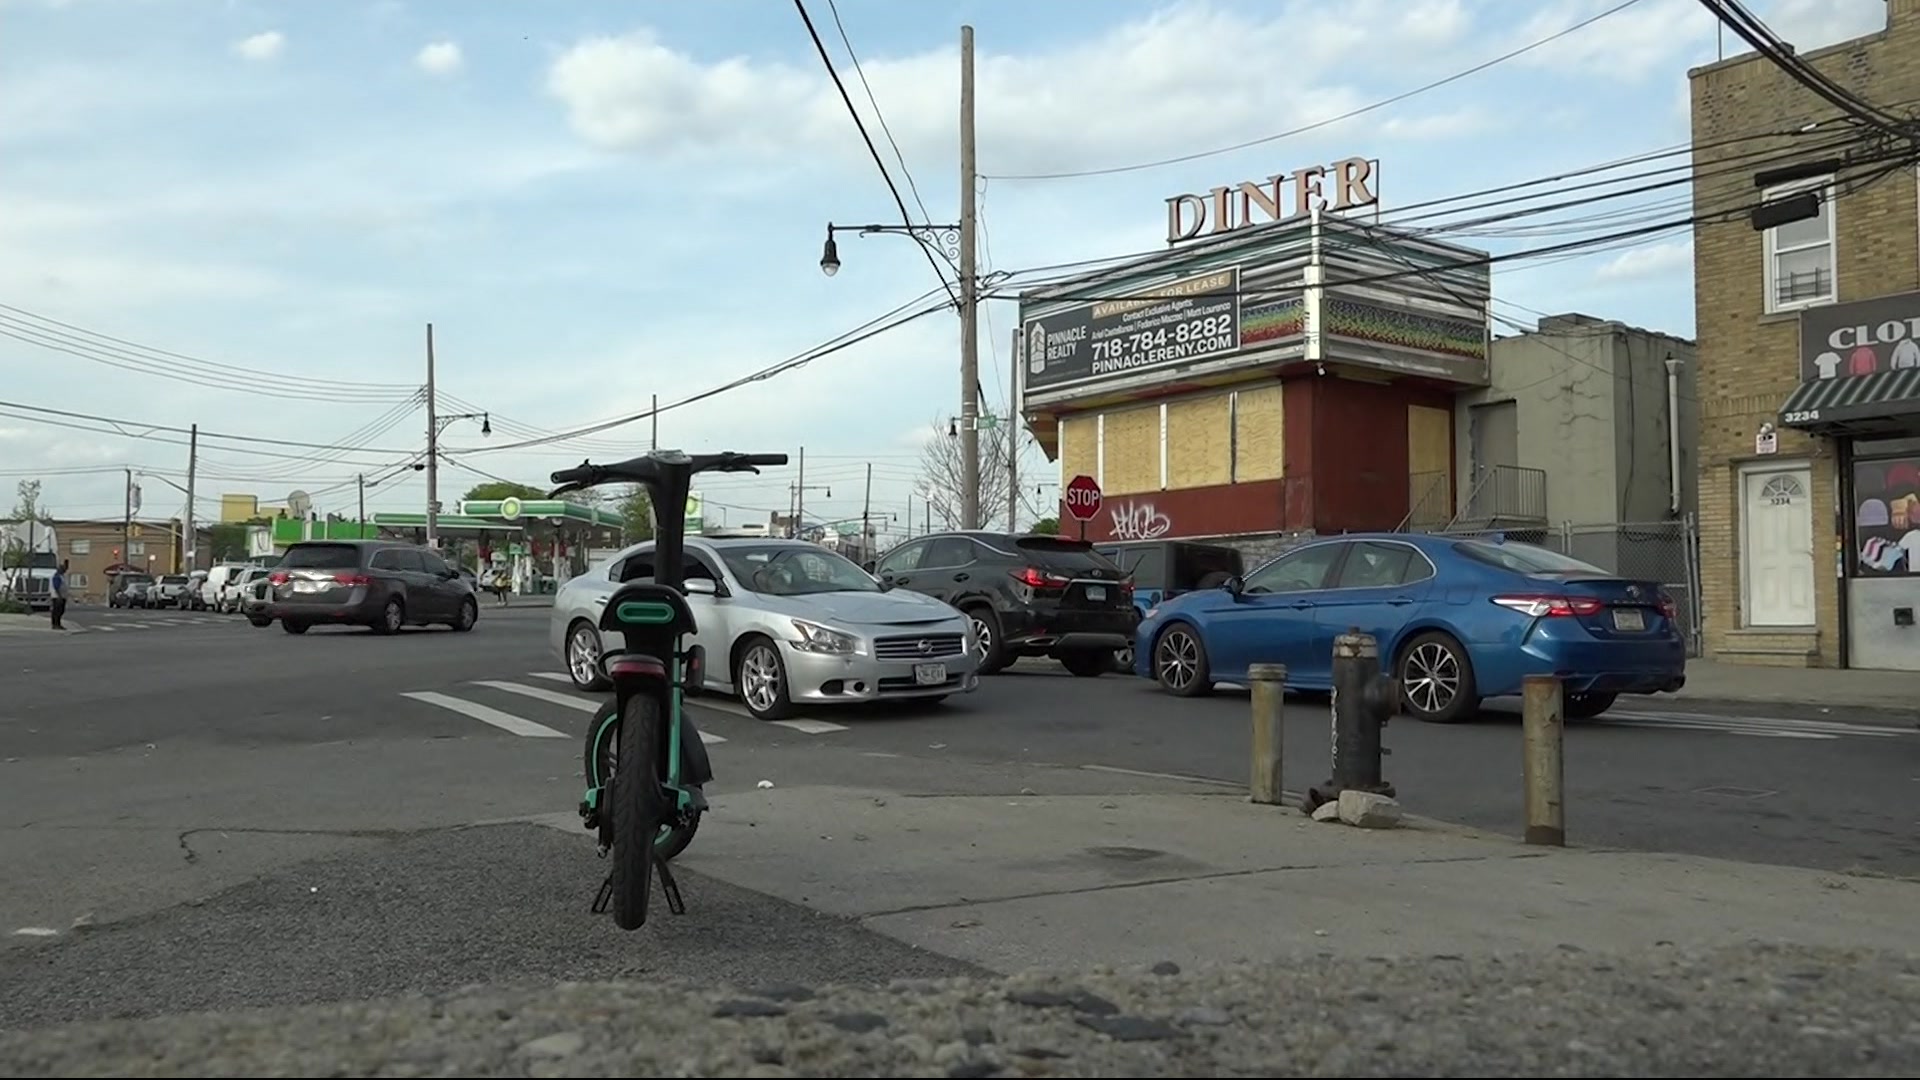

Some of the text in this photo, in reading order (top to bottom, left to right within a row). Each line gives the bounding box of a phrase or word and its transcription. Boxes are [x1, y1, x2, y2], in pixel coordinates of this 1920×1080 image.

[1165, 157, 1376, 242] DINER
[1187, 275, 1226, 293] LEASE
[1122, 312, 1145, 323] Contact
[1145, 304, 1171, 317] Exclusive
[1047, 325, 1087, 346] PINNACLE
[1091, 314, 1231, 361] 718-784-8282
[1047, 342, 1077, 360] REALTY
[1092, 334, 1232, 374] PINNACLERENY.COM
[1785, 410, 1820, 422] 3234
[1068, 488, 1100, 506] STOP
